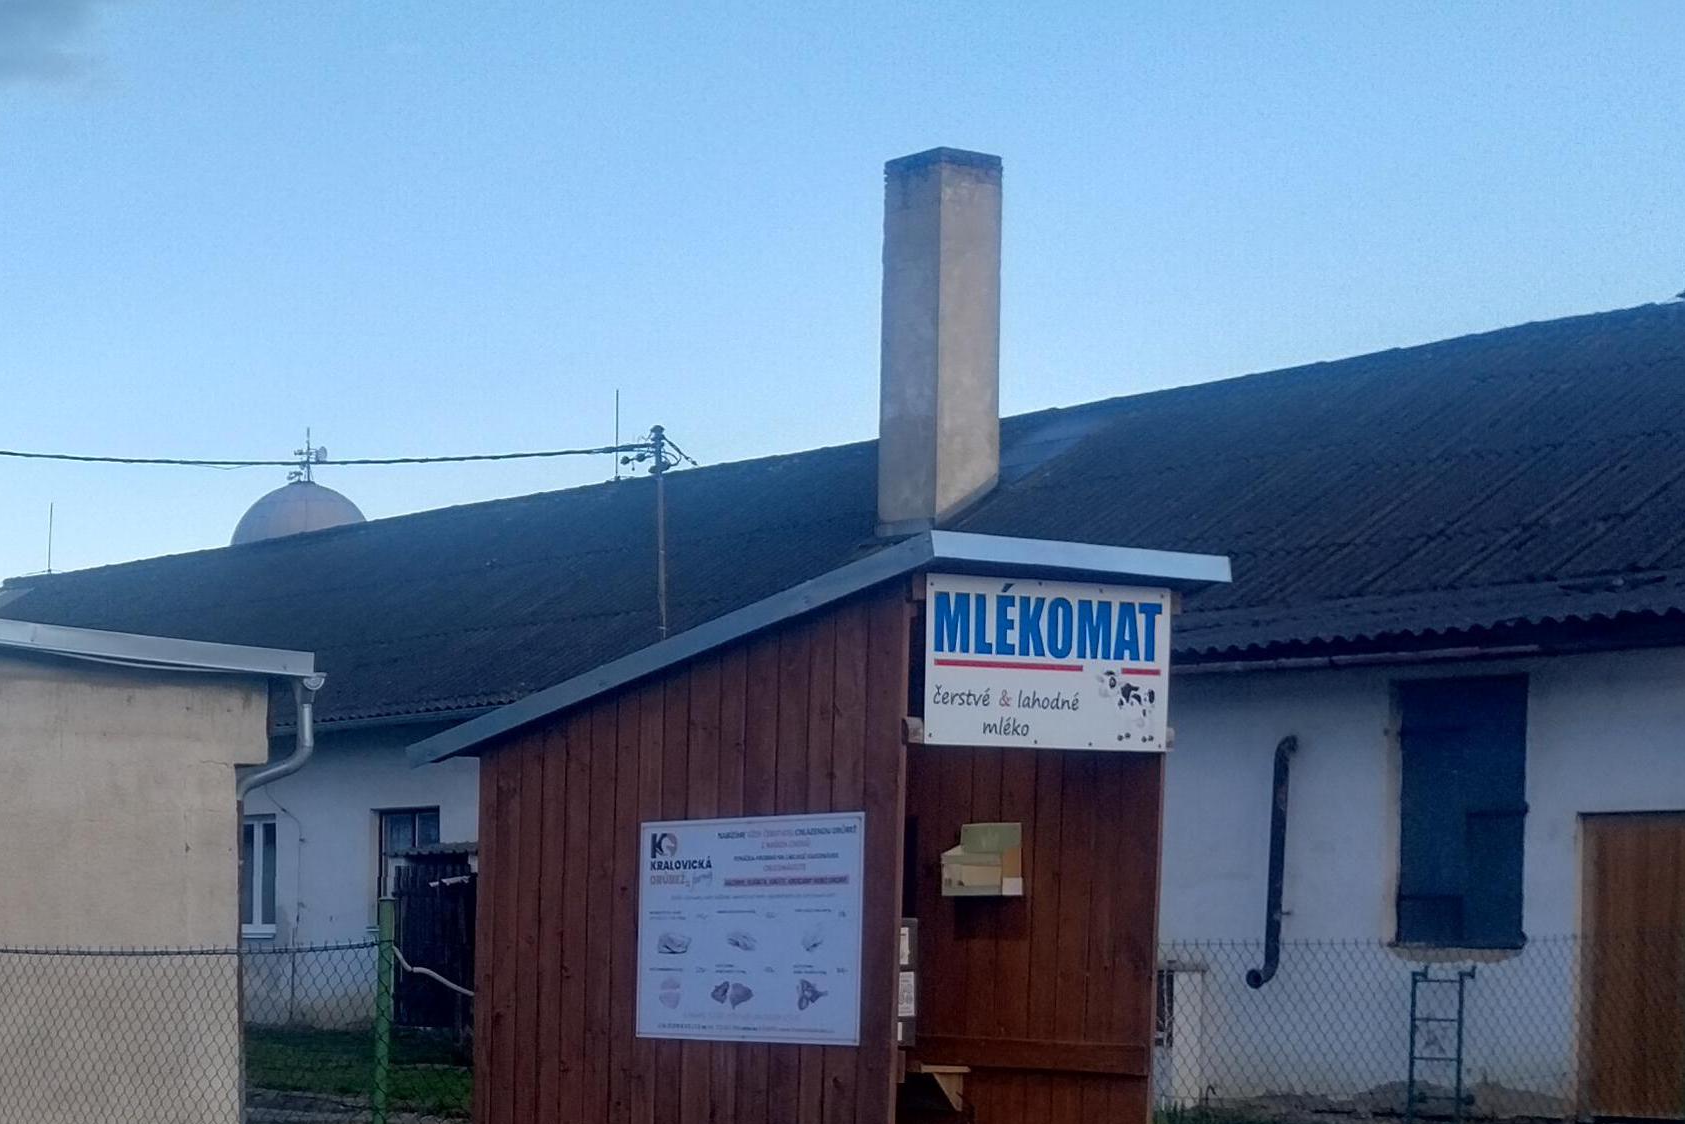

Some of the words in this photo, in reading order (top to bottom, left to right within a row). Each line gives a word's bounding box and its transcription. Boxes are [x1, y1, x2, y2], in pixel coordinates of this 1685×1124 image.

[933, 583, 1163, 662] MLÉKOMAT
[933, 685, 990, 706] čerstvé
[1000, 690, 1011, 707] &
[1017, 690, 1079, 711] lahodné
[982, 716, 1029, 736] mléko
[650, 856, 712, 871] KRALOVICKÁ
